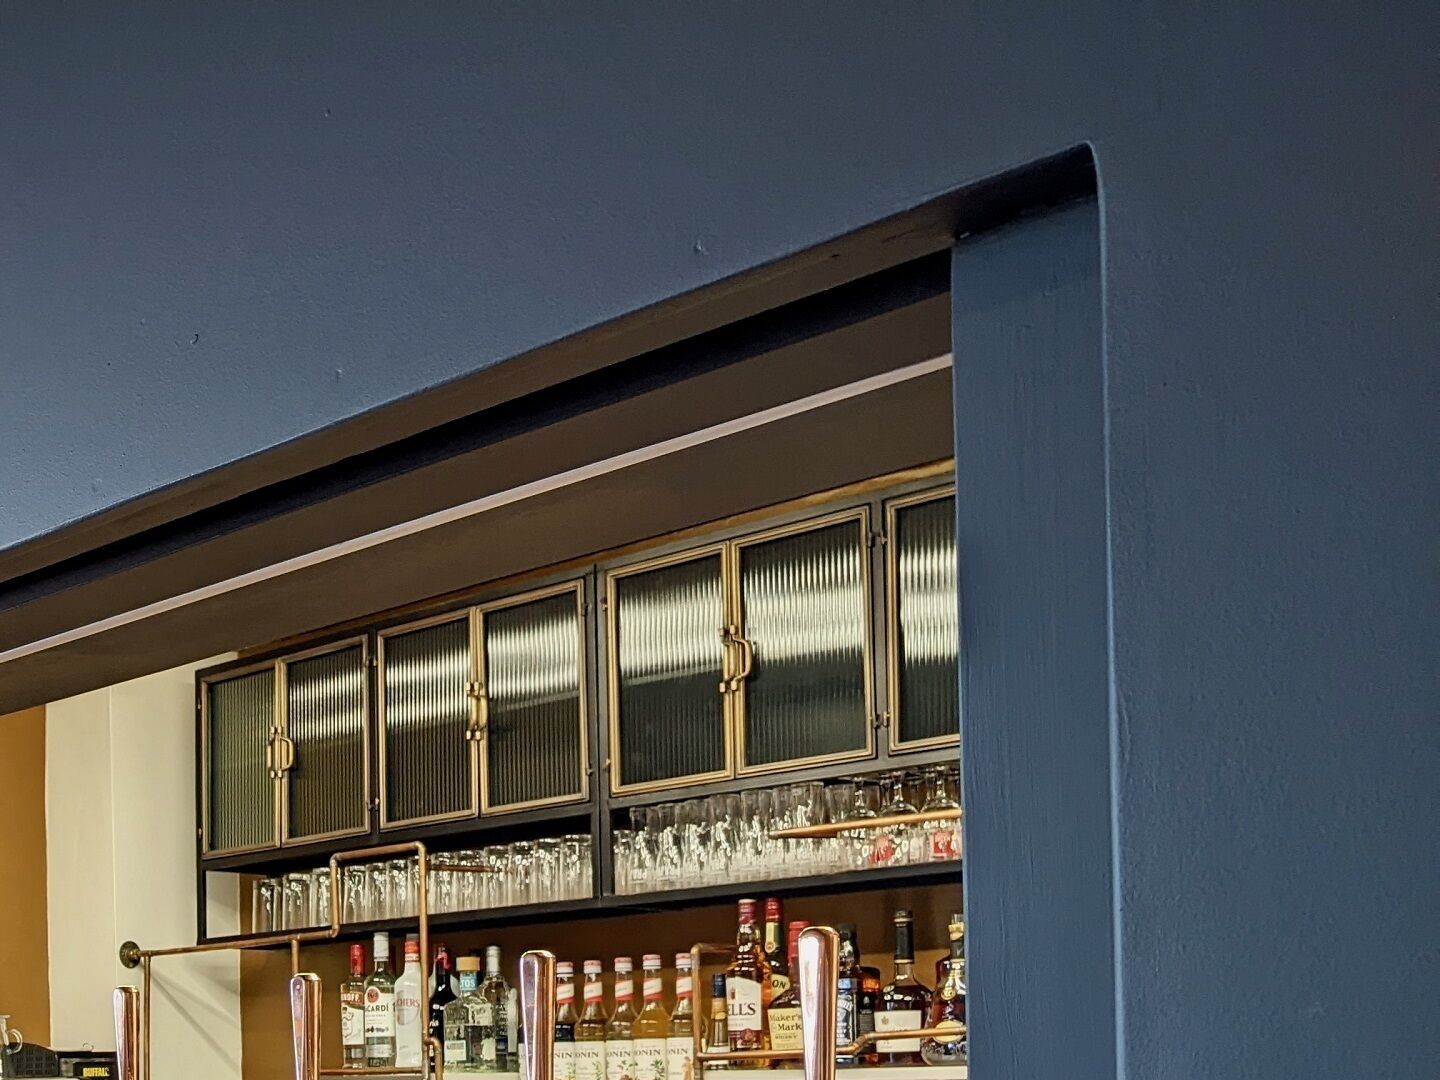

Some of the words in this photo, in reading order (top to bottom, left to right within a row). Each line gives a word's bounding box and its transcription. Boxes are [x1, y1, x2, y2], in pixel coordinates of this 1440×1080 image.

[727, 1002, 757, 1016] ELL'S
[777, 1023, 803, 1032] Mark
[575, 1051, 600, 1059] ONIN
[608, 1050, 632, 1058] ONIN
[636, 1048, 661, 1056] ONIN
